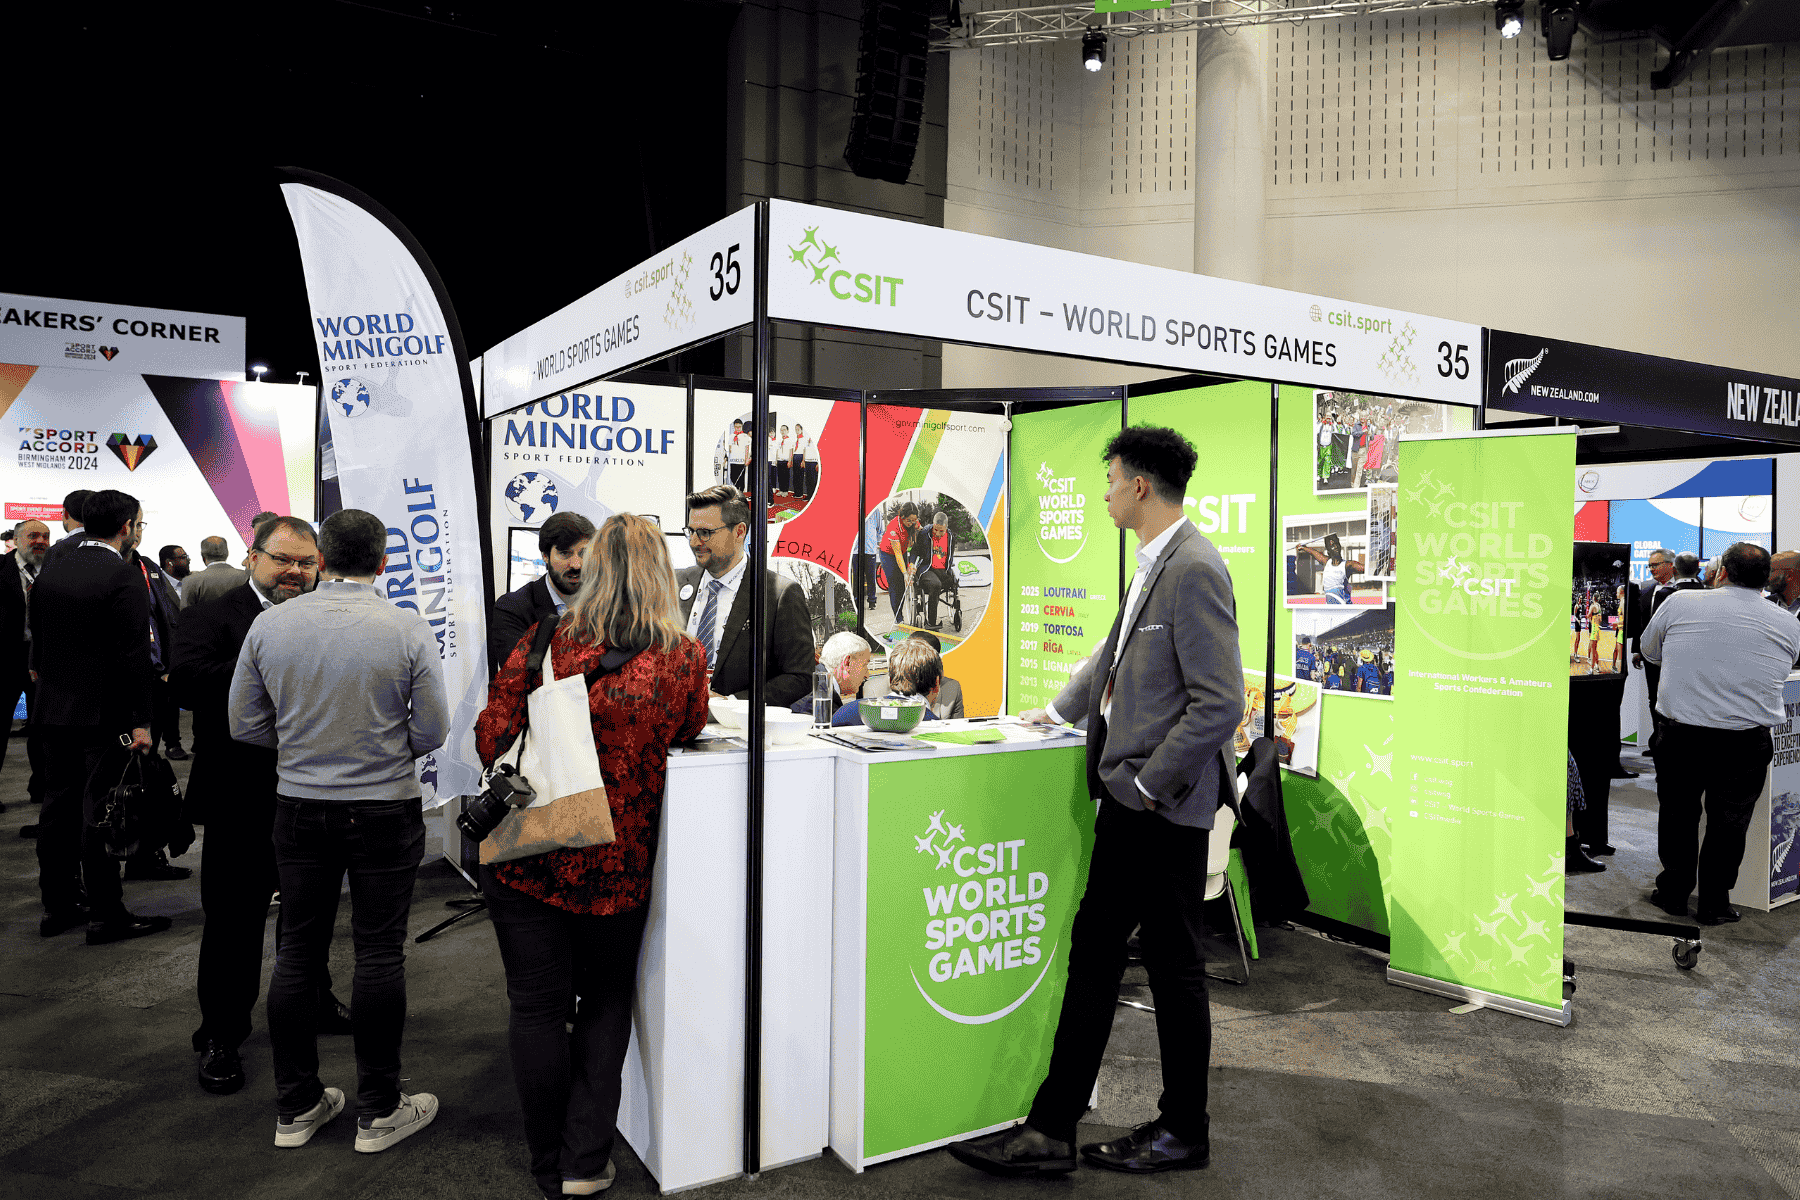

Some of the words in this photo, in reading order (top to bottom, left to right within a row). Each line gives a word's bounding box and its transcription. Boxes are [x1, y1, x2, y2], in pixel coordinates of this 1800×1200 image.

[634, 257, 674, 295] csit.sport
[709, 242, 741, 302] 35
[828, 269, 904, 307] CSIT
[0, 307, 103, 332] AKERS’
[112, 318, 221, 344] CORNER
[316, 313, 414, 338] WORLD
[966, 289, 1031, 324] CSIT
[1062, 302, 1157, 342] WORLD
[1165, 318, 1256, 356] SPORTS
[1264, 333, 1337, 368] GAMES
[1327, 309, 1393, 336] csit.sport
[322, 335, 445, 361] MINIGOLF
[537, 350, 565, 381] WORLD
[567, 332, 601, 369] SPORTS
[603, 314, 640, 353] GAMES
[1437, 340, 1470, 380] 35
[324, 364, 358, 373] SPORT
[364, 358, 429, 370] FEDERATION
[511, 393, 636, 423] ORLD
[1726, 381, 1760, 422] NEW
[19, 440, 99, 454] ACCORD
[34, 428, 98, 442] SPORT
[504, 419, 675, 455] MINIGOLF
[18, 453, 66, 463] BIRMINGHAM
[68, 455, 98, 471] 2024
[503, 452, 550, 462] SPORT
[559, 455, 645, 467] FEDERATION
[1048, 477, 1077, 493] CSIT
[1038, 493, 1087, 510] WORLD
[1443, 501, 1525, 529] CSIT
[1039, 509, 1085, 525] SPORTS
[1040, 525, 1083, 540] GAMES
[1413, 532, 1554, 559] WORLD
[442, 509, 455, 603] FEDERATION
[776, 540, 812, 558] FOR
[816, 549, 844, 575] ALL
[1217, 544, 1256, 554] Amateurs
[1415, 560, 1550, 589] SPORTS
[1463, 577, 1517, 598] CSIT
[1021, 585, 1040, 597] 2025
[1043, 586, 1087, 599] LOUTRAKI
[1418, 588, 1544, 619] GAMES
[1020, 604, 1040, 615] 2023
[1043, 605, 1075, 618] CERVIA
[448, 612, 458, 658] SPORT
[1020, 621, 1039, 633] 2019
[1043, 623, 1084, 637] TORTOSA
[1020, 639, 1038, 650] 2017
[1020, 657, 1038, 669] 2015
[1408, 669, 1460, 682] International
[1462, 673, 1498, 685] Workers
[1500, 676, 1507, 685] &
[1509, 677, 1553, 688] Amateurs
[1434, 682, 1462, 693] Sports
[1463, 684, 1524, 697] Confederation
[1410, 754, 1474, 768] www.csit.sport
[953, 839, 1026, 878] CSIT
[922, 871, 1049, 917] WORLD
[924, 902, 1047, 951] SPORTS
[928, 935, 1042, 983] GAMES
